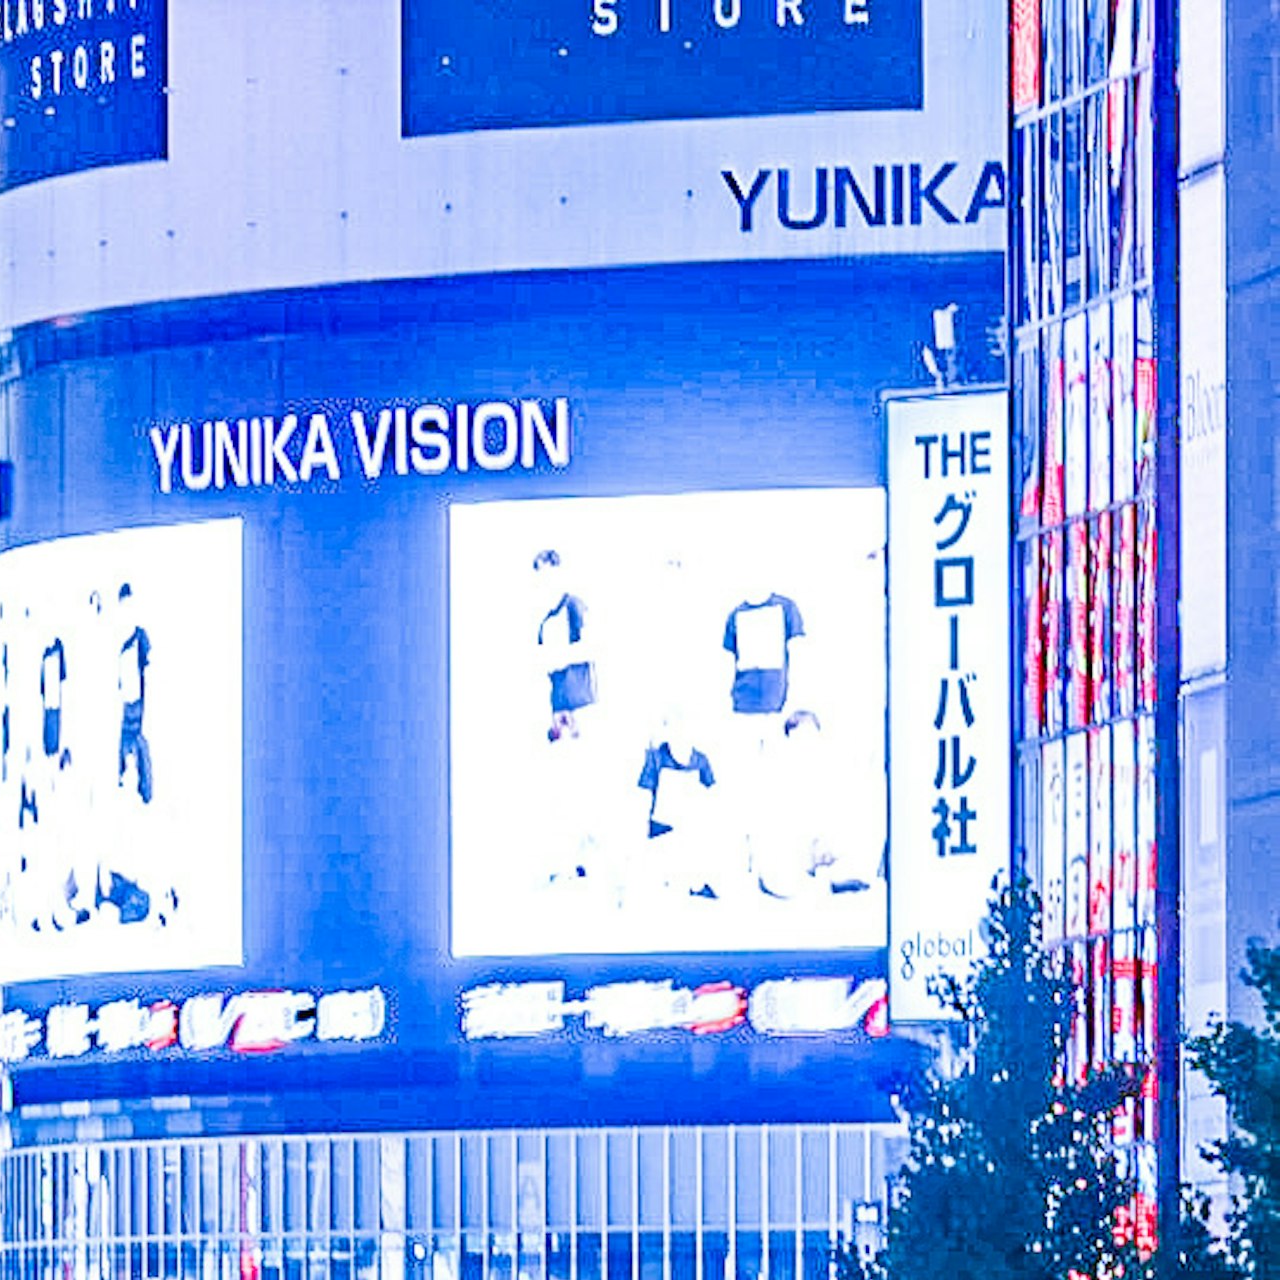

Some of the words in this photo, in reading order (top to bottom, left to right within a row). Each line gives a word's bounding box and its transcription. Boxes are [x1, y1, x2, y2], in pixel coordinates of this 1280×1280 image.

[31, 34, 146, 100] STORE
[721, 161, 1006, 232] YUNIKA
[150, 413, 340, 494] YUNIKA
[350, 398, 571, 478] VISION
[915, 431, 991, 476] THE
[931, 490, 977, 857] グローバル社
[900, 929, 973, 981] global
